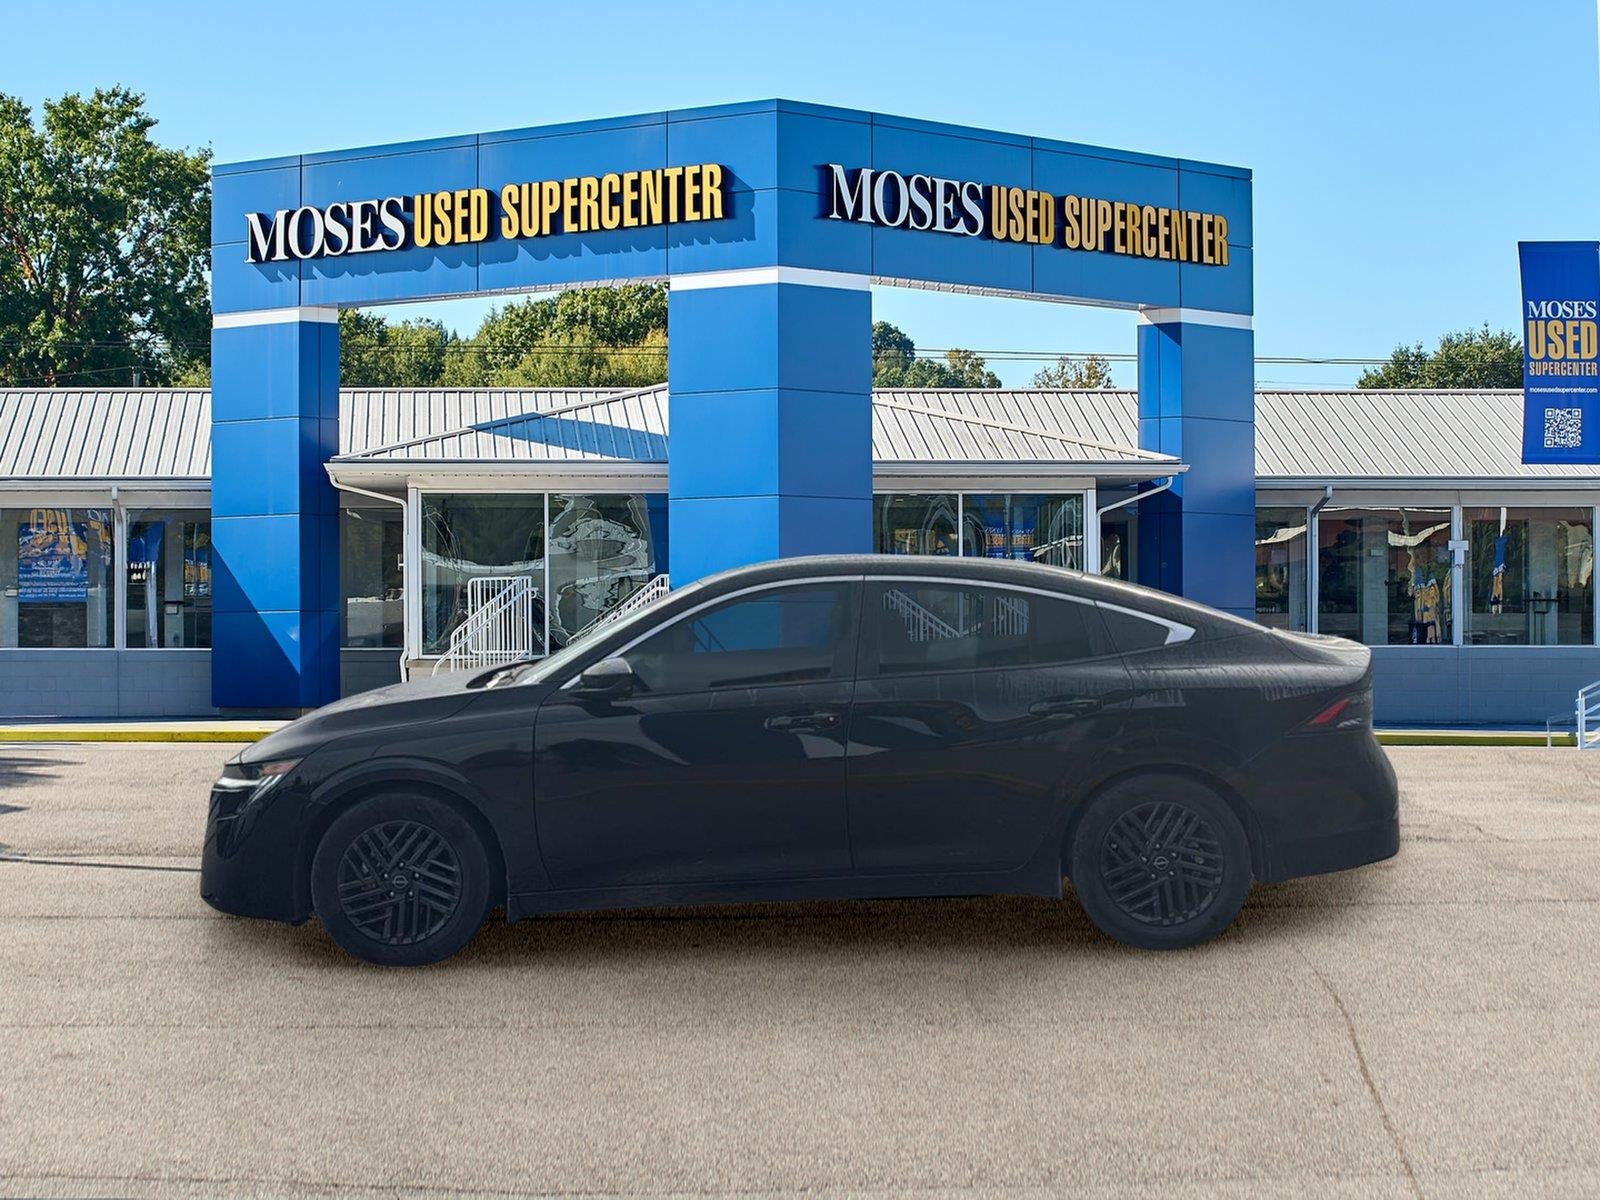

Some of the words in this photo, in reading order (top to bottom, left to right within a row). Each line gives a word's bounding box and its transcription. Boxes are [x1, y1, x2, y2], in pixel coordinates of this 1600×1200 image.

[244, 197, 406, 263] MOSES
[413, 188, 489, 248] USED
[501, 163, 723, 240] SUPERCENTER
[829, 163, 985, 237] MOSES
[991, 185, 1055, 244] USED
[1064, 194, 1229, 266] SUPERCENTER
[1527, 300, 1597, 319] MOSES
[1528, 320, 1598, 360] USED
[1529, 361, 1598, 376] SUPERCENTER
